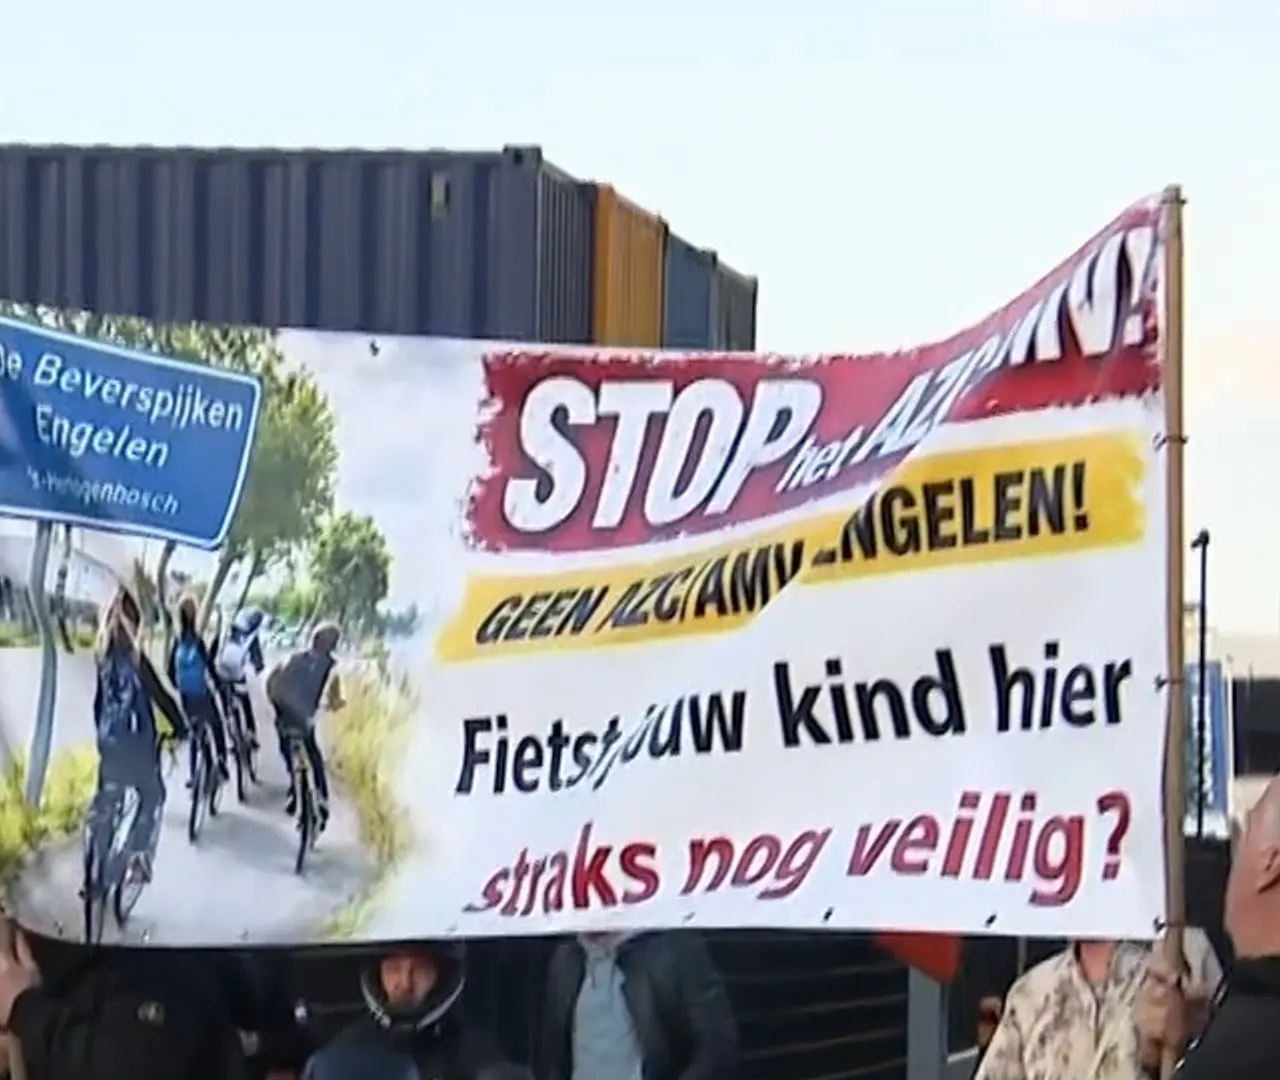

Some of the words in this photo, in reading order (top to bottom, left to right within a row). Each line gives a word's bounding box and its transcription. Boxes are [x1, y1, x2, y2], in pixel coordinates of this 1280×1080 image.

[33, 352, 245, 434] Beverspijken
[35, 403, 169, 469] Engelen
[501, 375, 824, 532] STOP
[776, 424, 864, 495] het
[474, 585, 609, 645] GEEN
[811, 460, 1089, 567] NGELEN!
[773, 647, 967, 749] kind
[988, 639, 1134, 733] hier
[461, 818, 661, 918] straks
[679, 827, 833, 901] nog
[845, 789, 1134, 908] veilig?
